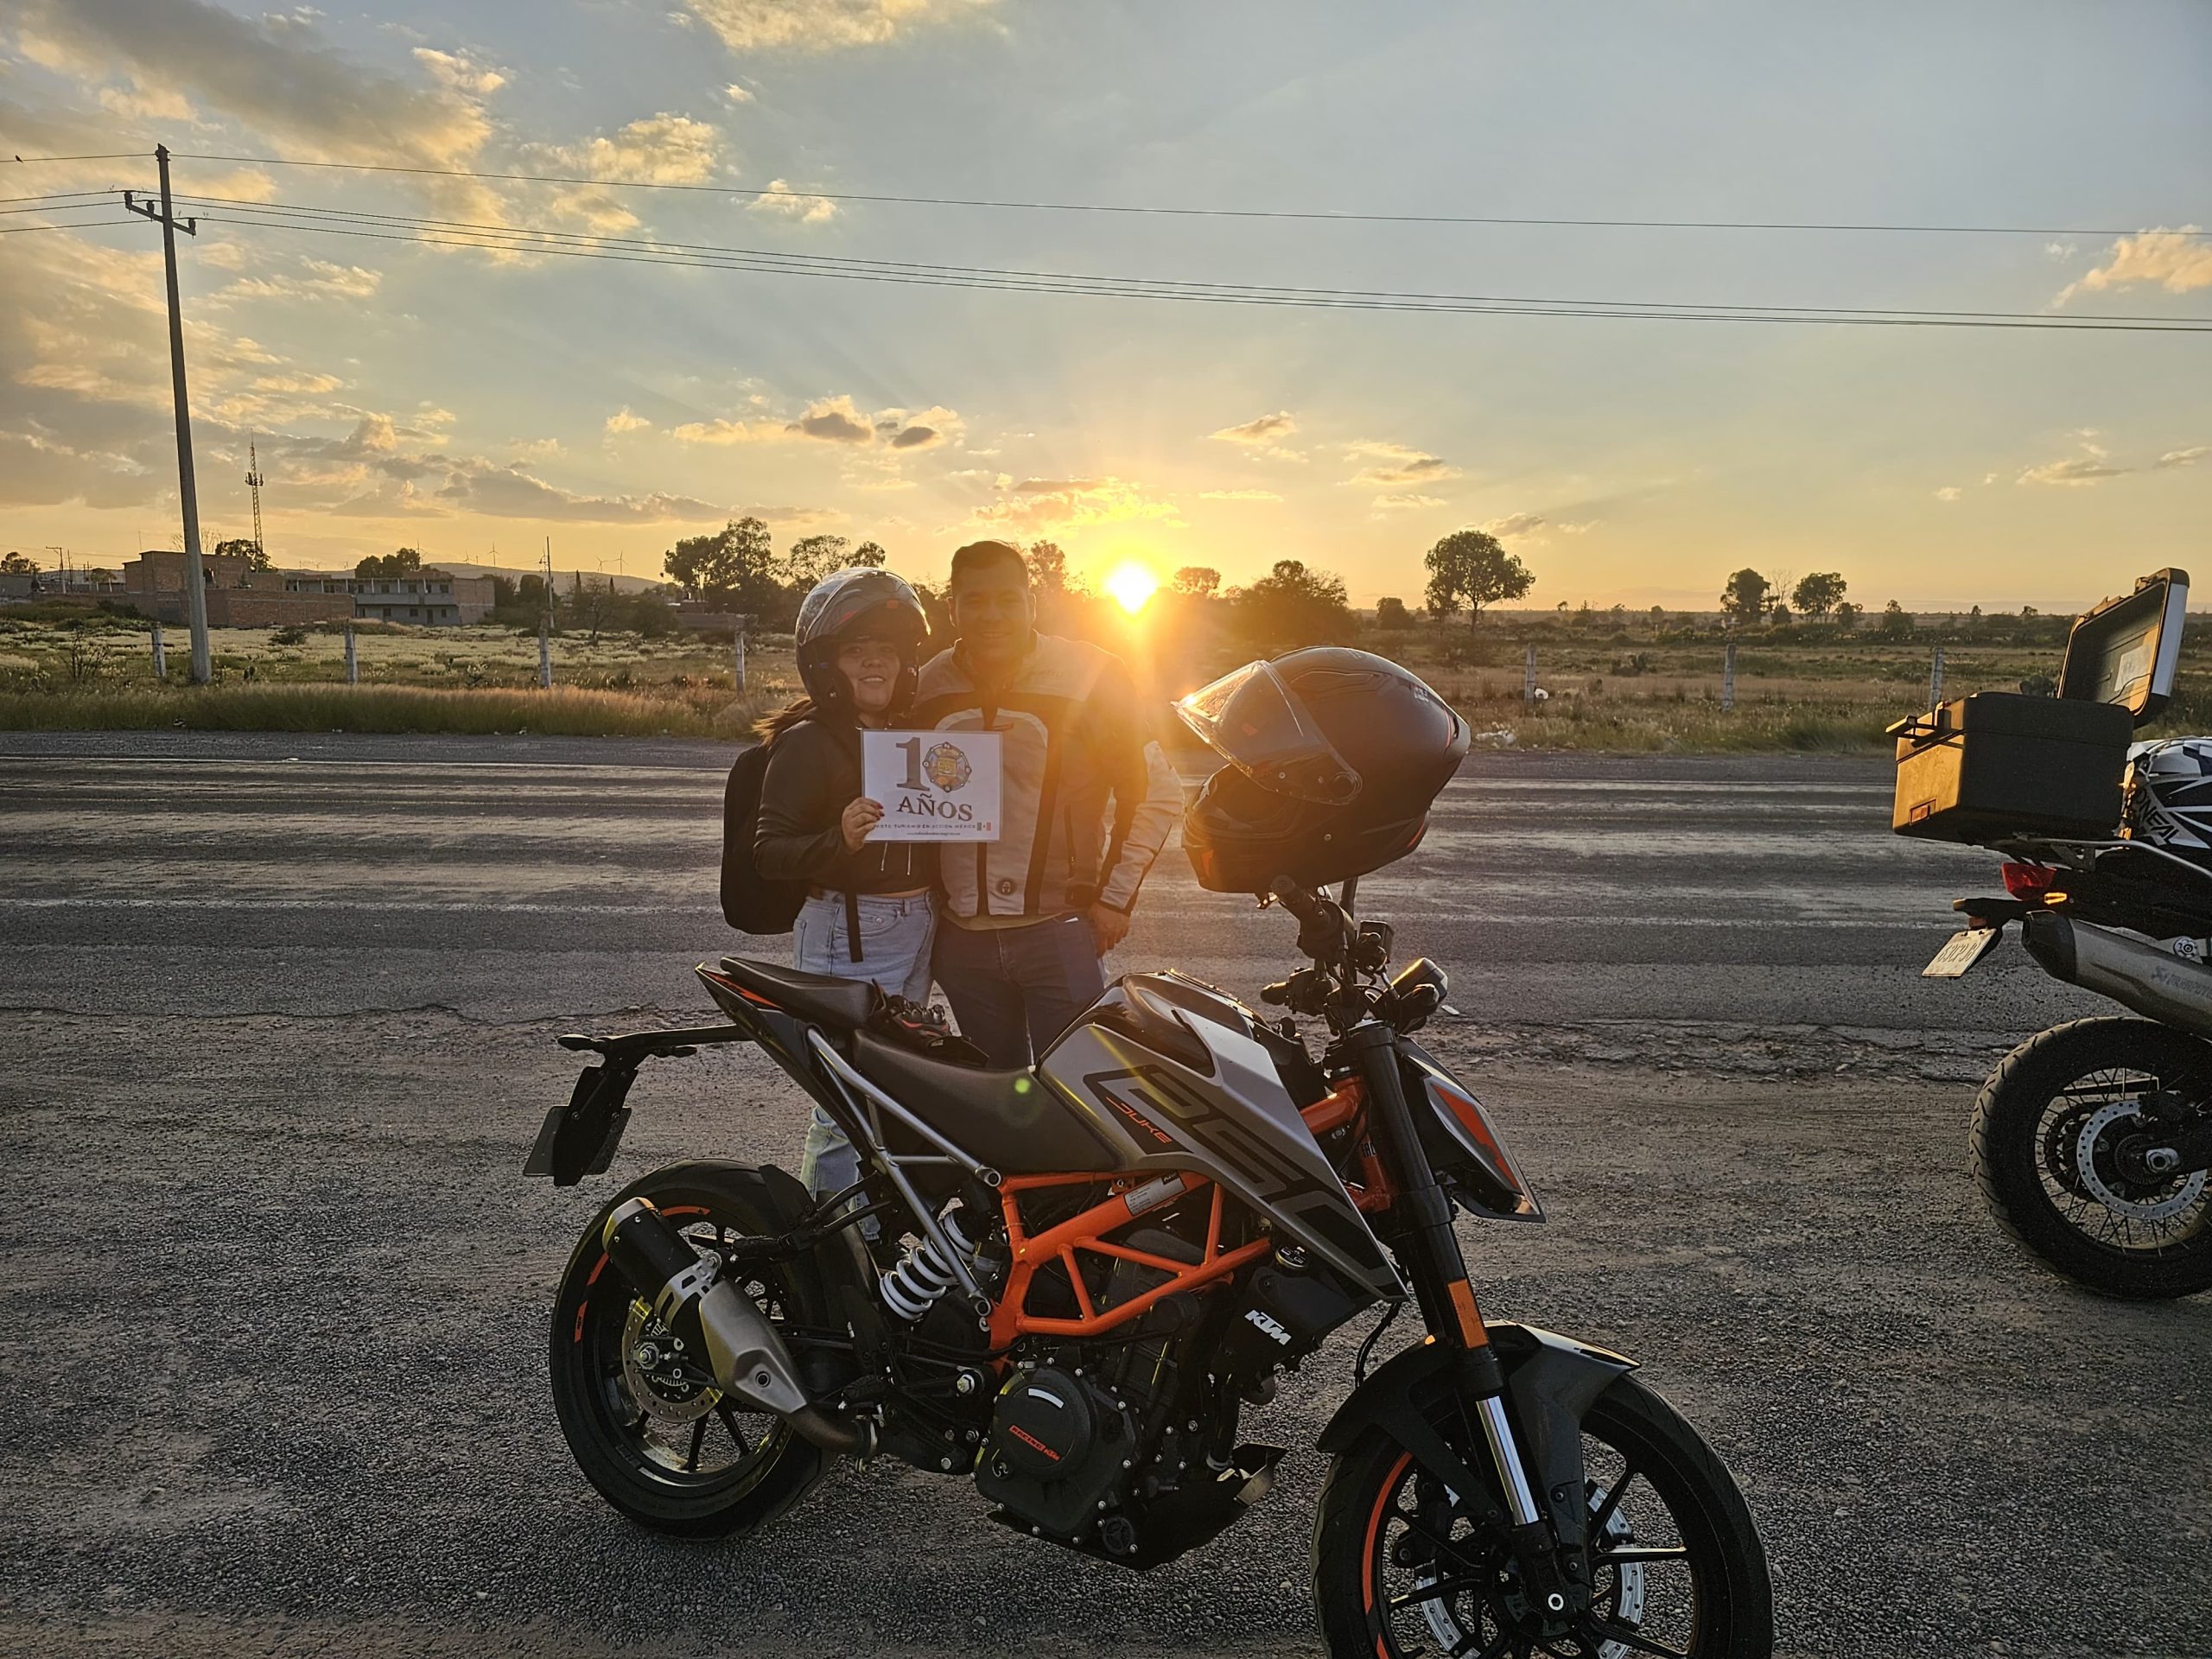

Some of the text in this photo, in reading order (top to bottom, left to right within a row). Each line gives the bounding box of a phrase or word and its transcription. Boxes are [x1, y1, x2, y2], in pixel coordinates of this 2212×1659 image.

[896, 792, 973, 822] AÑOS
[1105, 1096, 1173, 1144] DUKE
[1244, 1309, 1292, 1345] KTM
